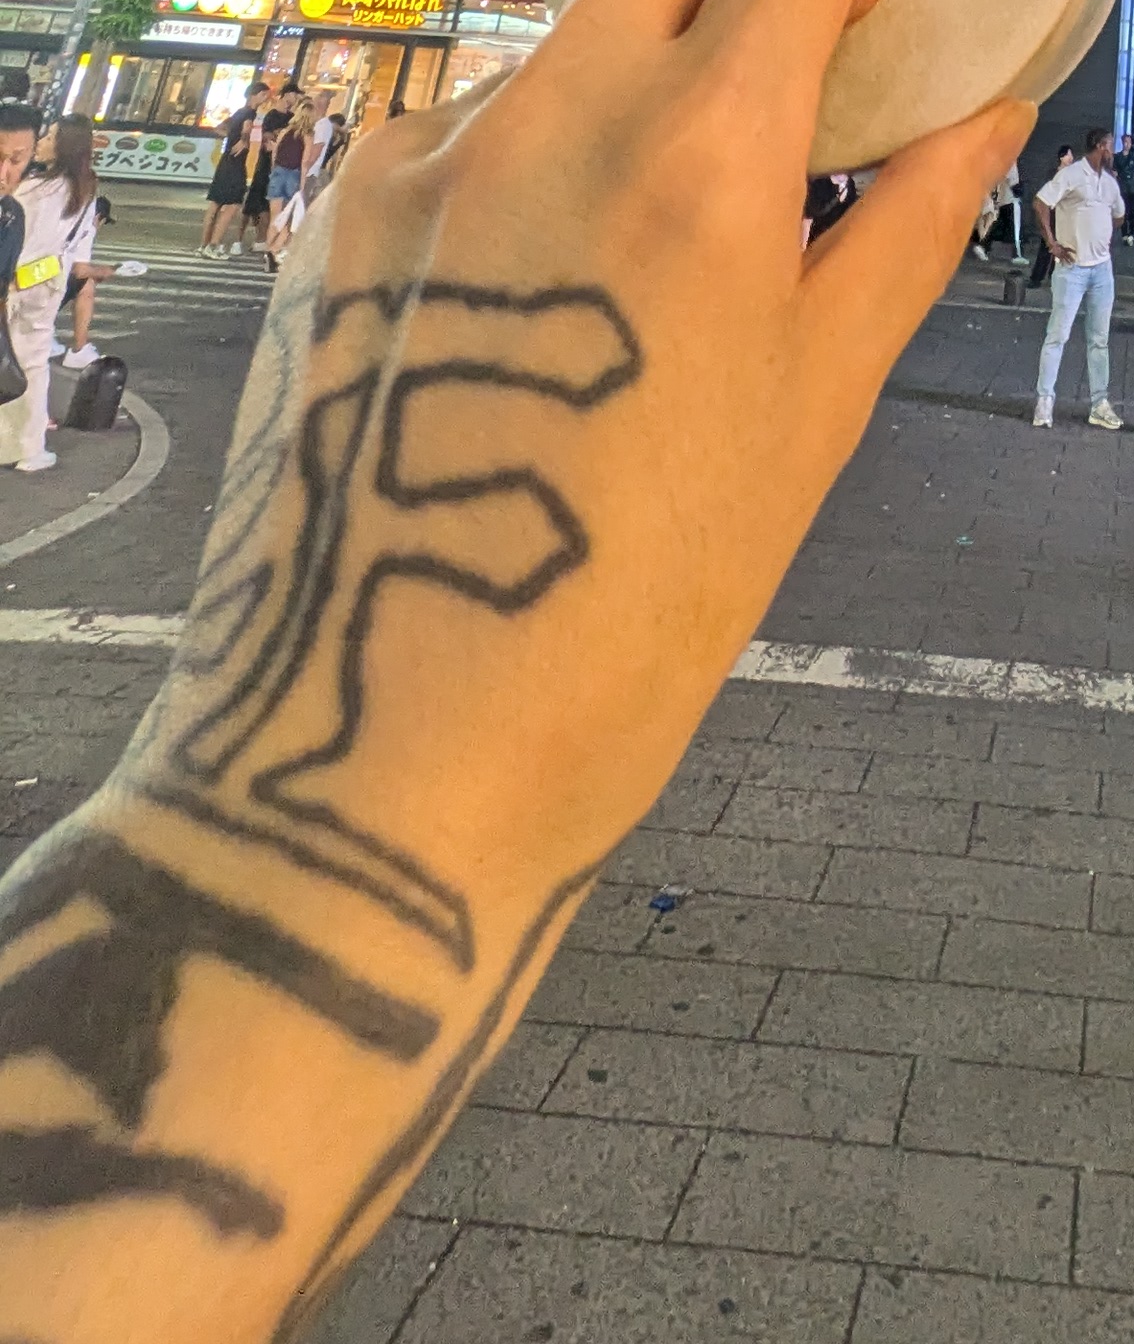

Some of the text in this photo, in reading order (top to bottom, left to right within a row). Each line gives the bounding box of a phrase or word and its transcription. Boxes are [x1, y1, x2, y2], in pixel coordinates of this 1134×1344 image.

[352, 9, 426, 26] リンガーハット
